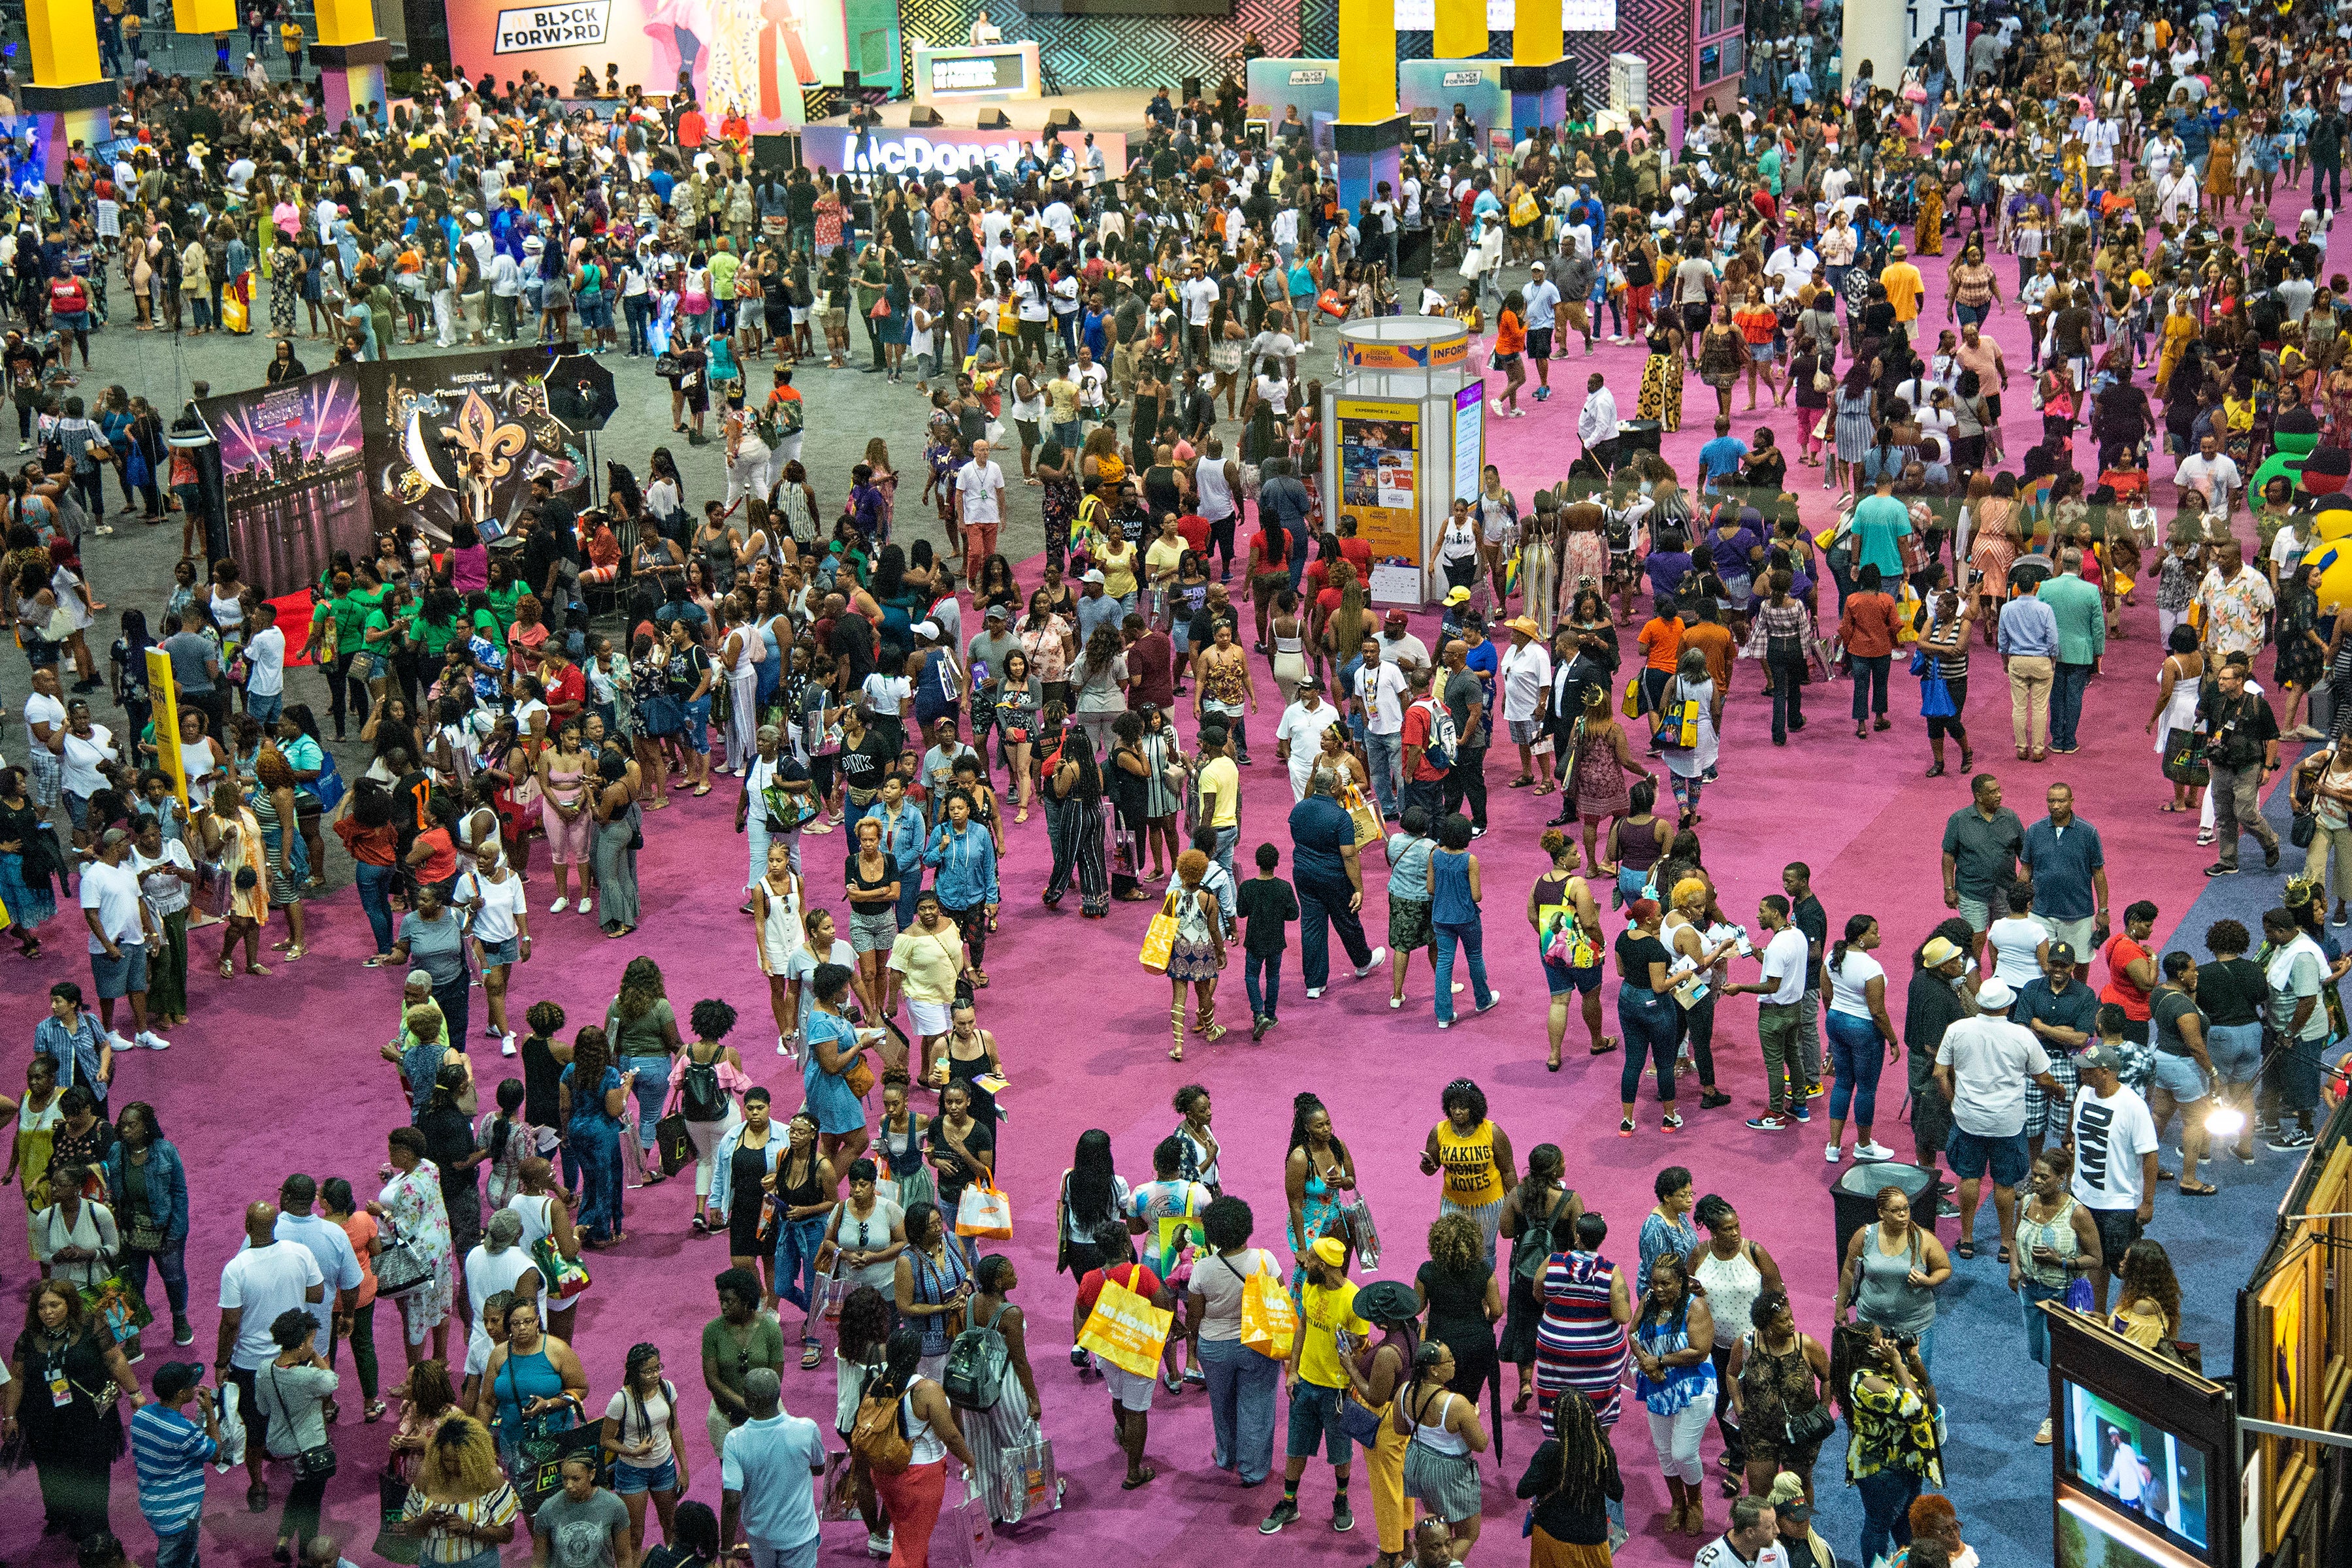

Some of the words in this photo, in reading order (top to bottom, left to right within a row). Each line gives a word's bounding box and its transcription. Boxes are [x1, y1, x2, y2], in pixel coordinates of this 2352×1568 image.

[457, 372, 487, 384] ESSENCE
[440, 386, 468, 397] Festival
[481, 384, 501, 394] 2018
[842, 754, 875, 774] PINK
[1441, 1145, 1492, 1162] MAKING
[2076, 1101, 2114, 1191] DKNY
[1444, 1162, 1490, 1175] MONEY
[1450, 1173, 1491, 1192] MOVES
[1156, 1208, 1182, 1217] VANS
